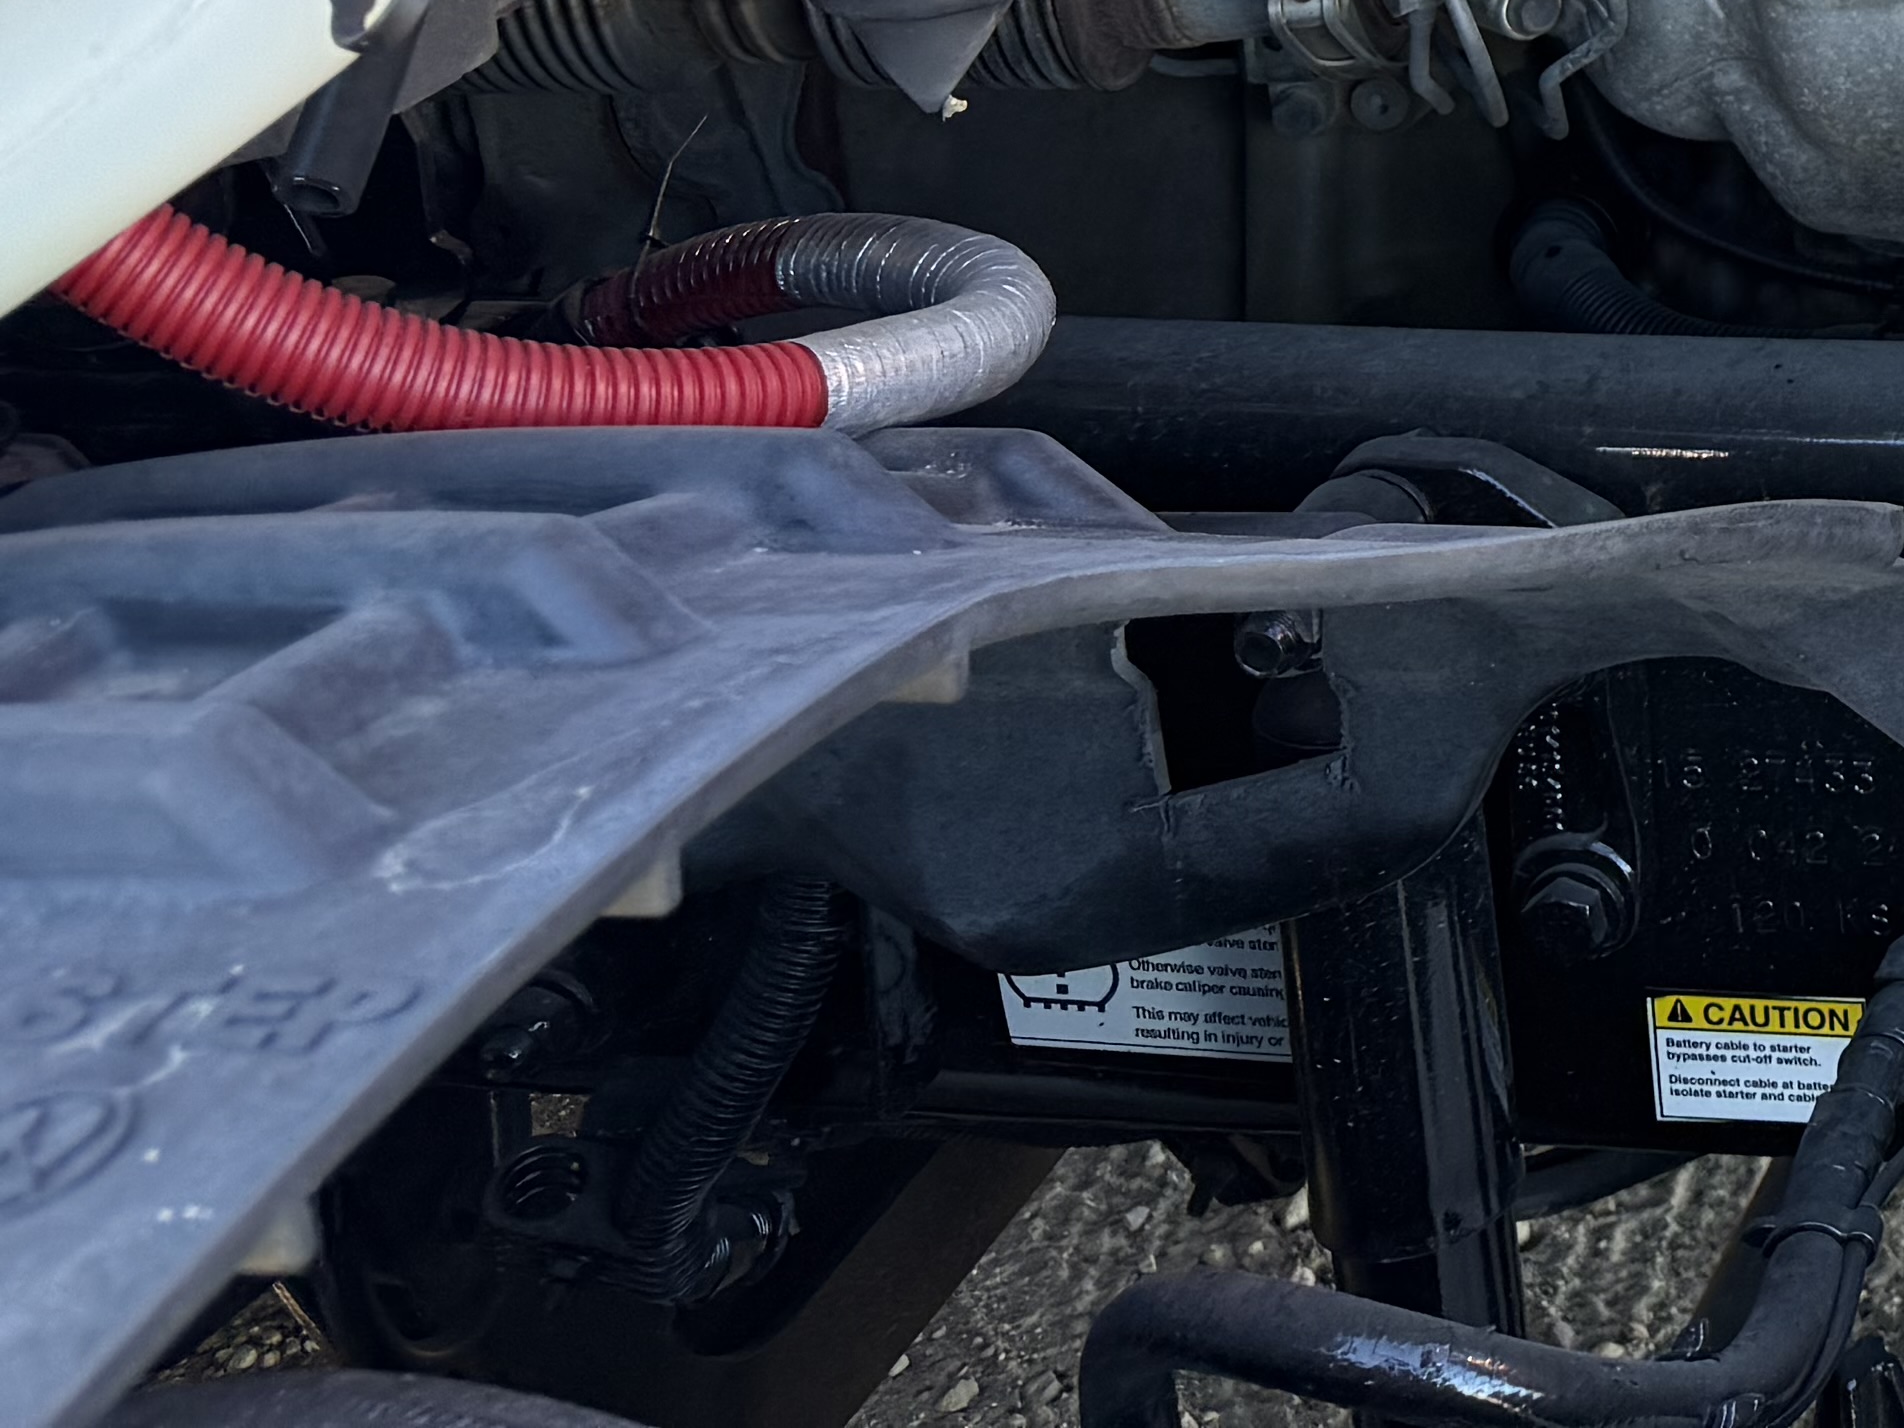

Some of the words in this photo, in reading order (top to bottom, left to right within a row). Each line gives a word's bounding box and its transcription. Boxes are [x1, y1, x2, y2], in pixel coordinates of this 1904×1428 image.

[1128, 958, 1205, 975] Otherwise
[1207, 964, 1248, 980] valve
[1130, 976, 1173, 992] brake
[1175, 981, 1226, 998] caliper
[1132, 1006, 1165, 1020] This
[1168, 1010, 1200, 1025] may
[1204, 1010, 1246, 1026] affect
[1703, 1002, 1849, 1031] CAUTION
[1135, 1026, 1200, 1045] resulting
[1204, 1030, 1218, 1043] in
[1221, 1031, 1263, 1048] injury
[1268, 1036, 1283, 1046] or
[1666, 1037, 1712, 1052] Battery
[1715, 1040, 1749, 1051] cable
[1753, 1042, 1766, 1052] to
[1769, 1043, 1811, 1053] starter
[1667, 1051, 1727, 1064] bypasses
[1731, 1052, 1772, 1064] cut-off
[1776, 1055, 1822, 1067] switch.
[1668, 1074, 1740, 1088] Disconnect
[1744, 1078, 1778, 1089] cable
[1782, 1080, 1793, 1089] at
[1670, 1087, 1712, 1099] isolate
[1715, 1090, 1758, 1100] starter
[1761, 1091, 1784, 1102] and
